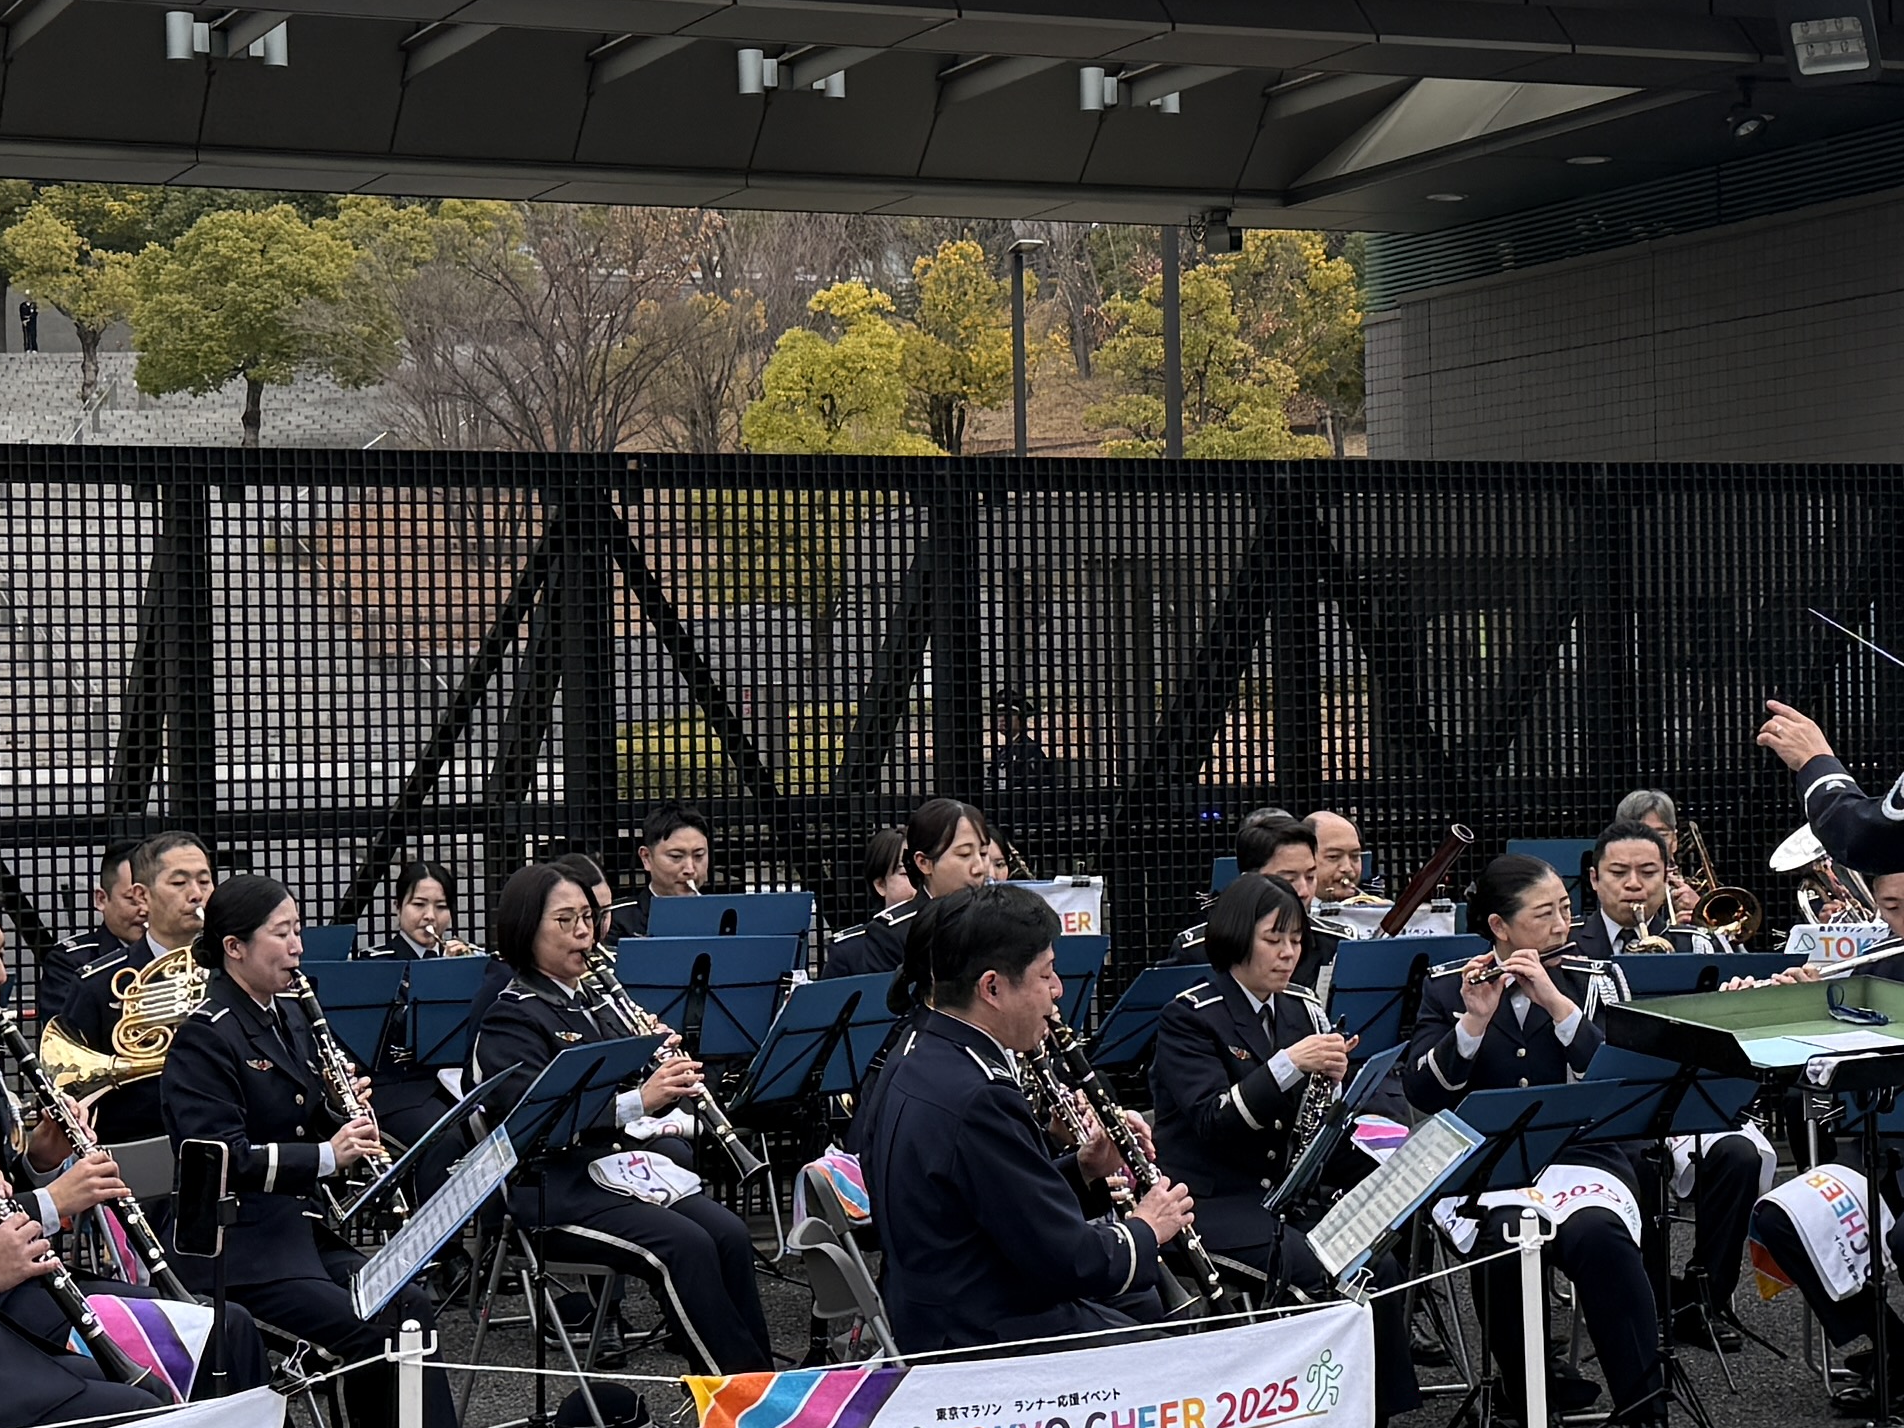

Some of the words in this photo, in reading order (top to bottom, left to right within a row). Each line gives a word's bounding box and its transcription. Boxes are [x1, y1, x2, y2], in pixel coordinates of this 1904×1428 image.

[1818, 936, 1875, 959] TOK
[1805, 1174, 1869, 1255] CHEER
[935, 1403, 1002, 1421] 東京マラソン
[1014, 1388, 1121, 1413] ランナー応援イベント
